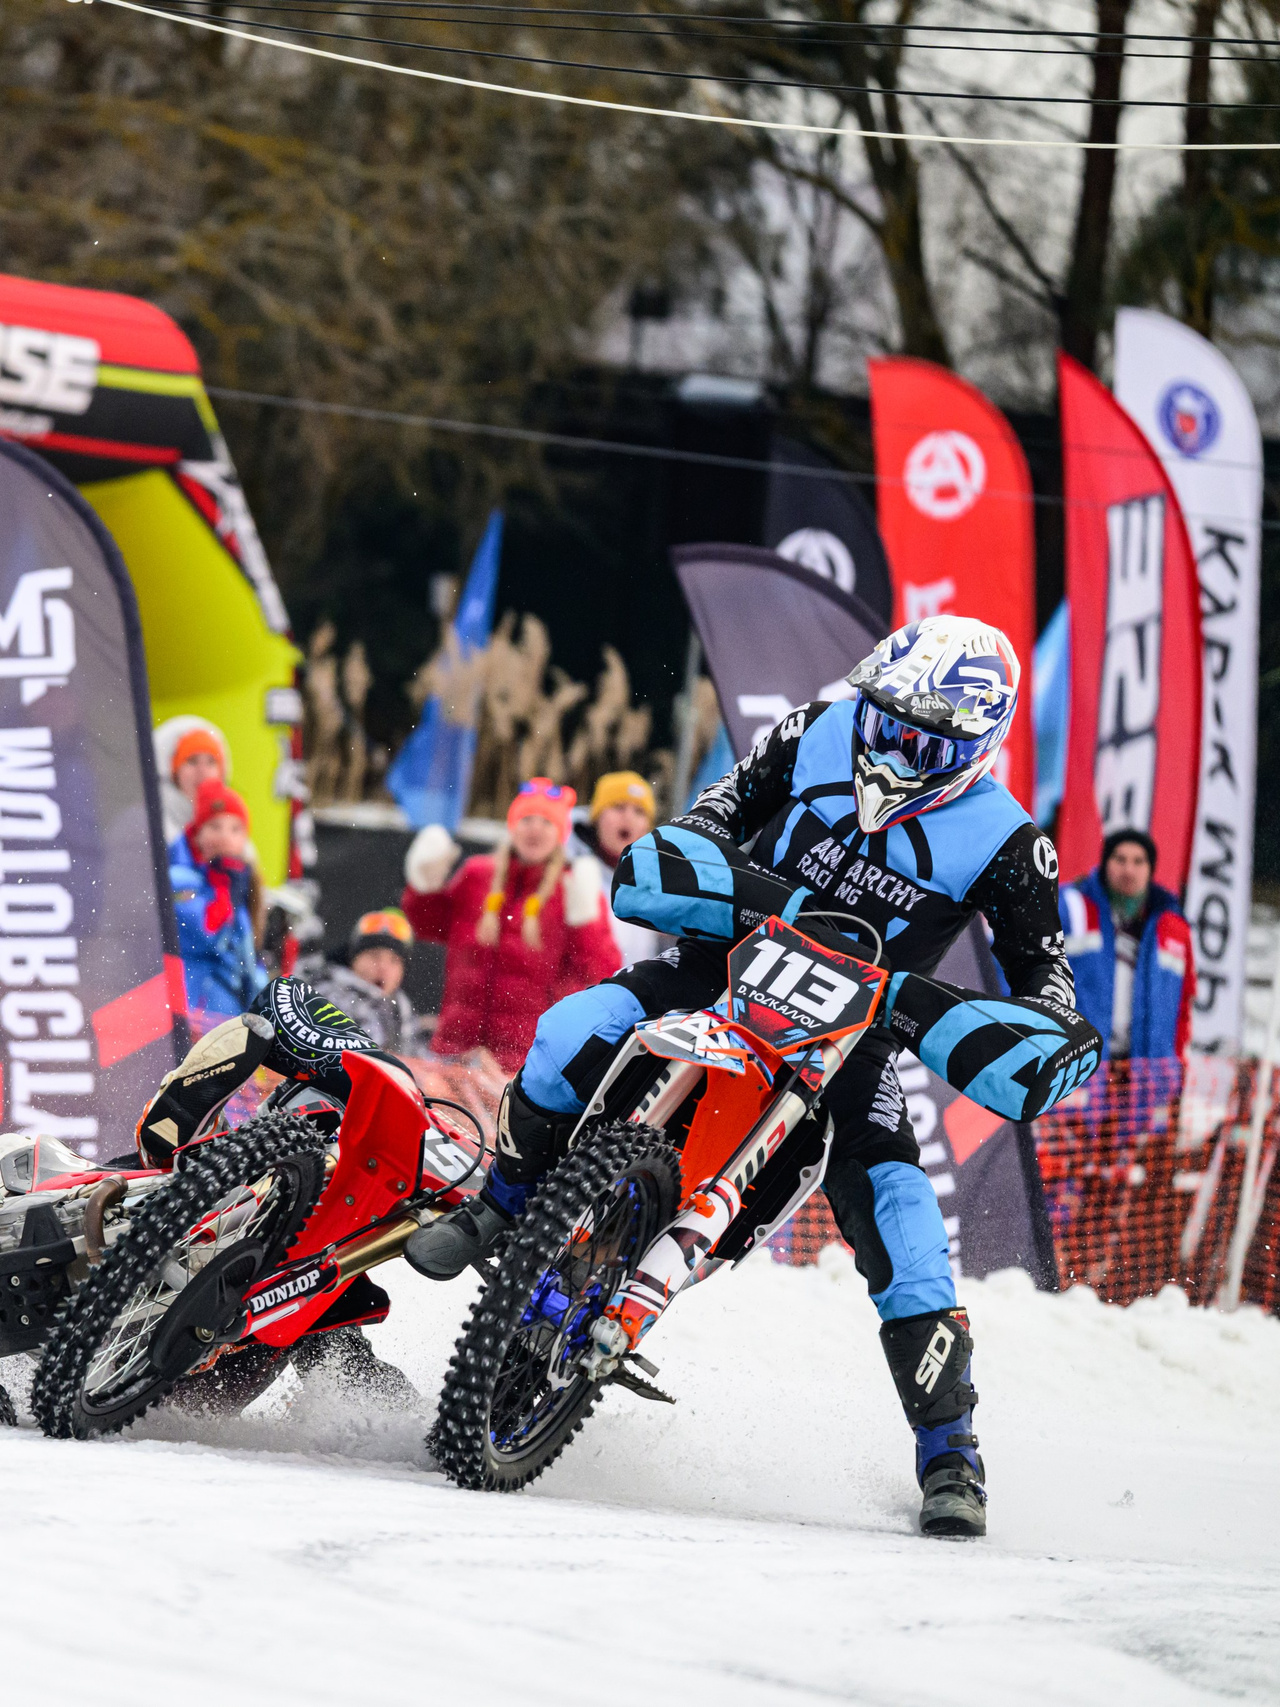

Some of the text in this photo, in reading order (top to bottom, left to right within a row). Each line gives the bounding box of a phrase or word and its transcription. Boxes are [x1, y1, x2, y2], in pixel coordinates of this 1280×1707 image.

[910, 694, 950, 711] Airoh
[736, 984, 747, 995] D.
[738, 938, 860, 1024] 113
[276, 982, 373, 1050] MONSTER ARMY
[251, 1269, 321, 1313] DUNLOP
[915, 1321, 956, 1395] SIDI
